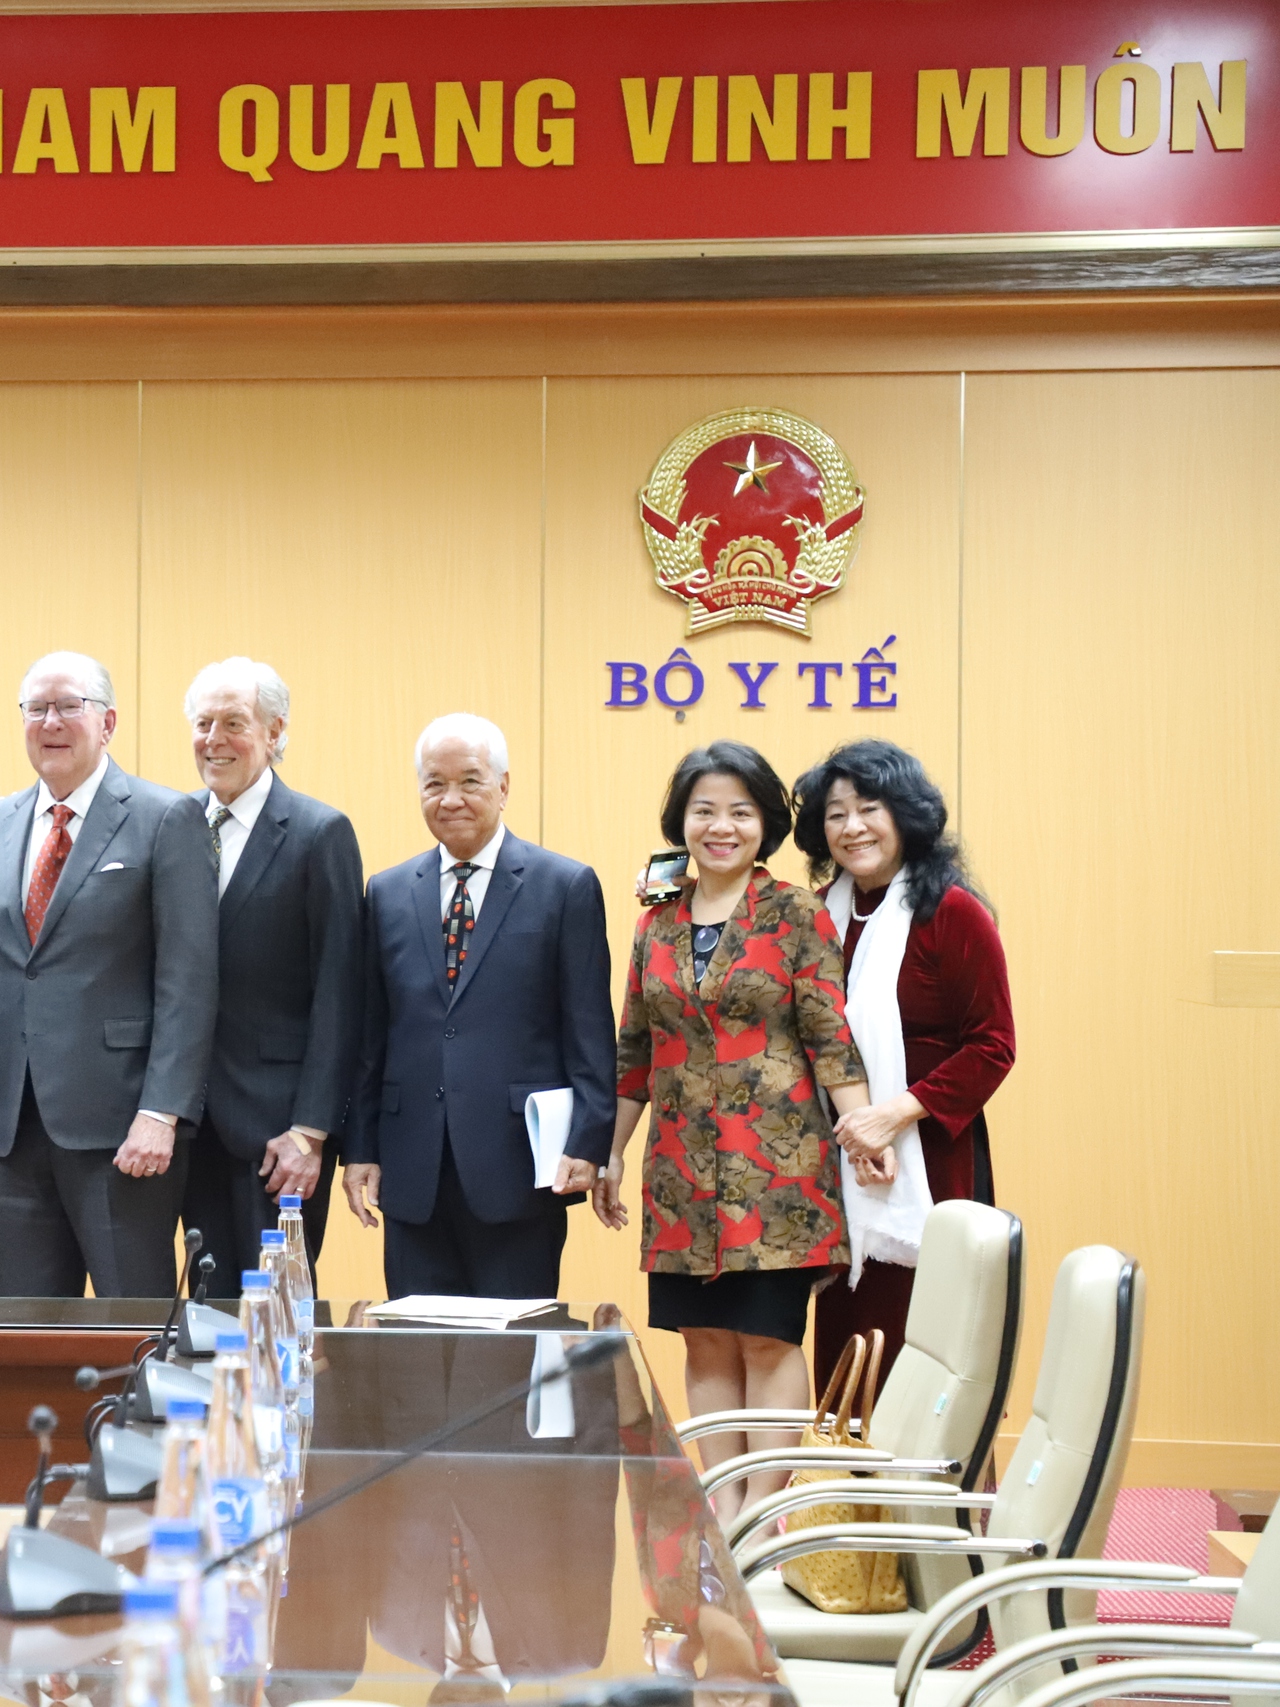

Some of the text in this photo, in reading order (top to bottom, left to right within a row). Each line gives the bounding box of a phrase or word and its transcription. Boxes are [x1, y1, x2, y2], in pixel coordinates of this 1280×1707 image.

[218, 78, 576, 183] QUANG
[621, 70, 873, 165] VINH
[915, 41, 1247, 158] MUÔN
[712, 590, 788, 609] VIỆT NAM
[605, 634, 898, 722] BỘ Y TẾ
